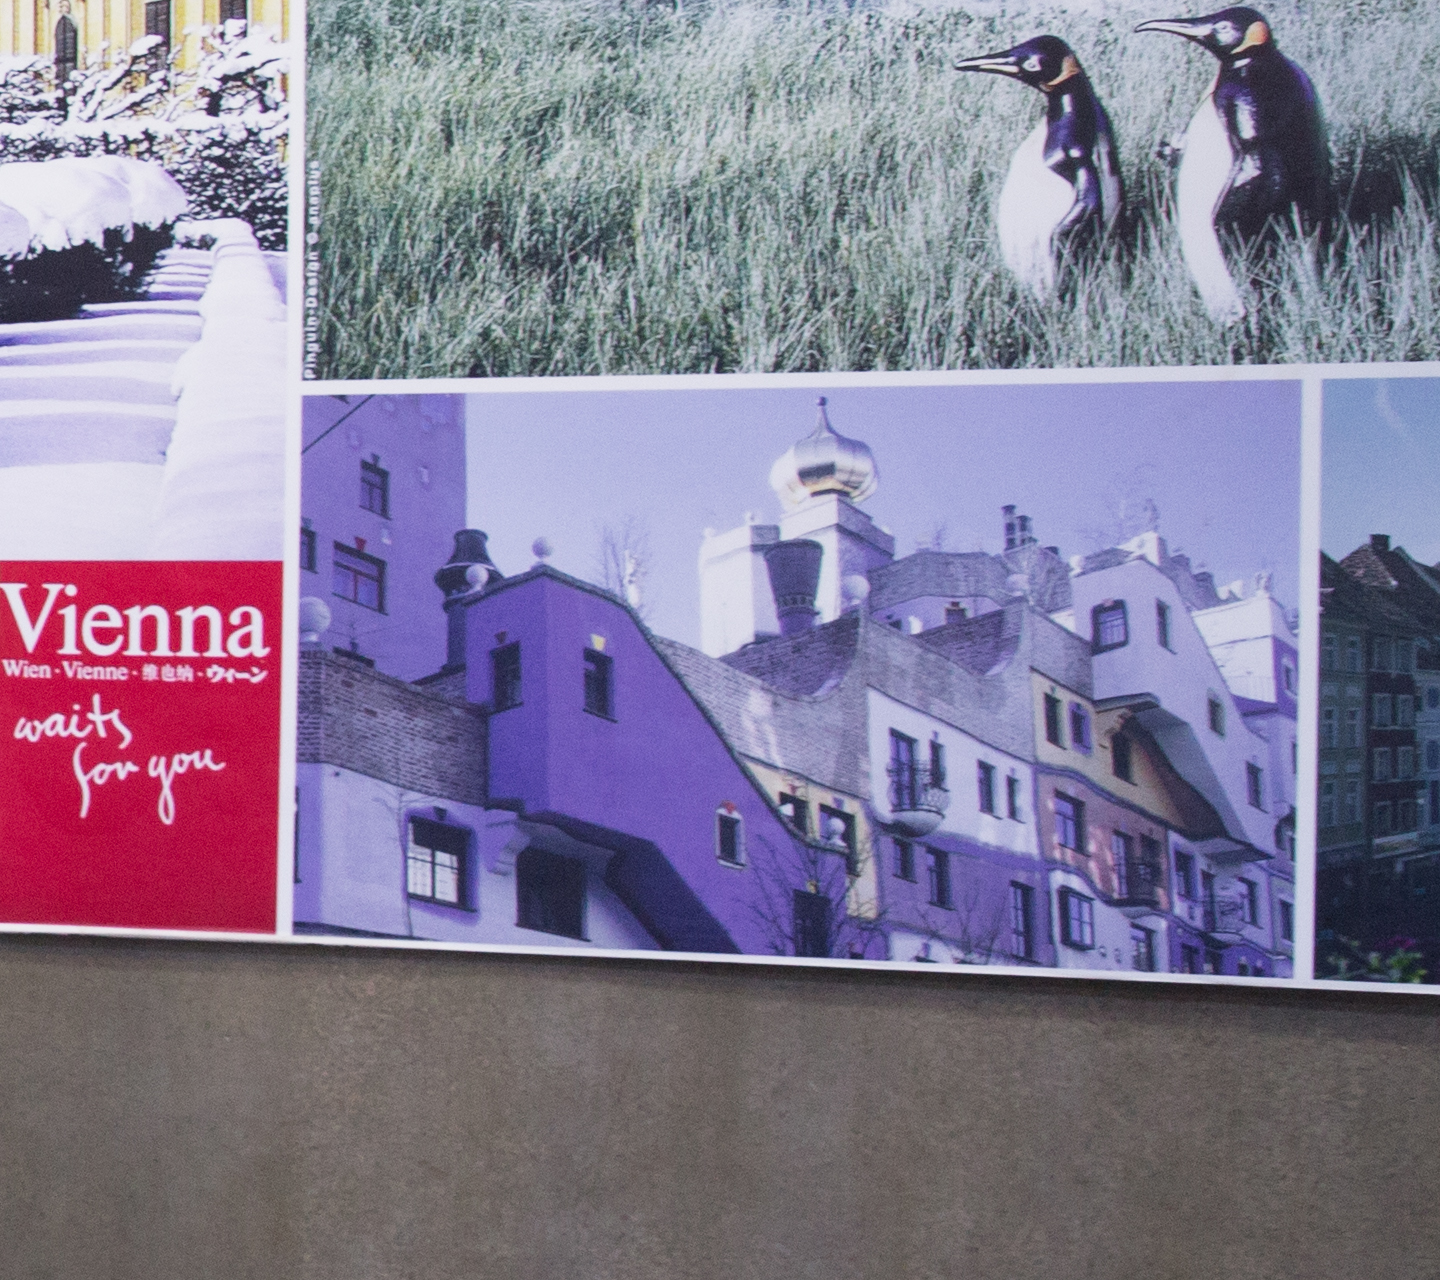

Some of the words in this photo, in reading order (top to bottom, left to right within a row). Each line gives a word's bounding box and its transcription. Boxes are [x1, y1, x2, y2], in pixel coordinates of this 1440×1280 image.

[1, 659, 52, 679] Wien
[62, 661, 129, 681] Vienne
[14, 693, 133, 750] waits
[73, 741, 140, 819] for
[148, 749, 227, 826] you
